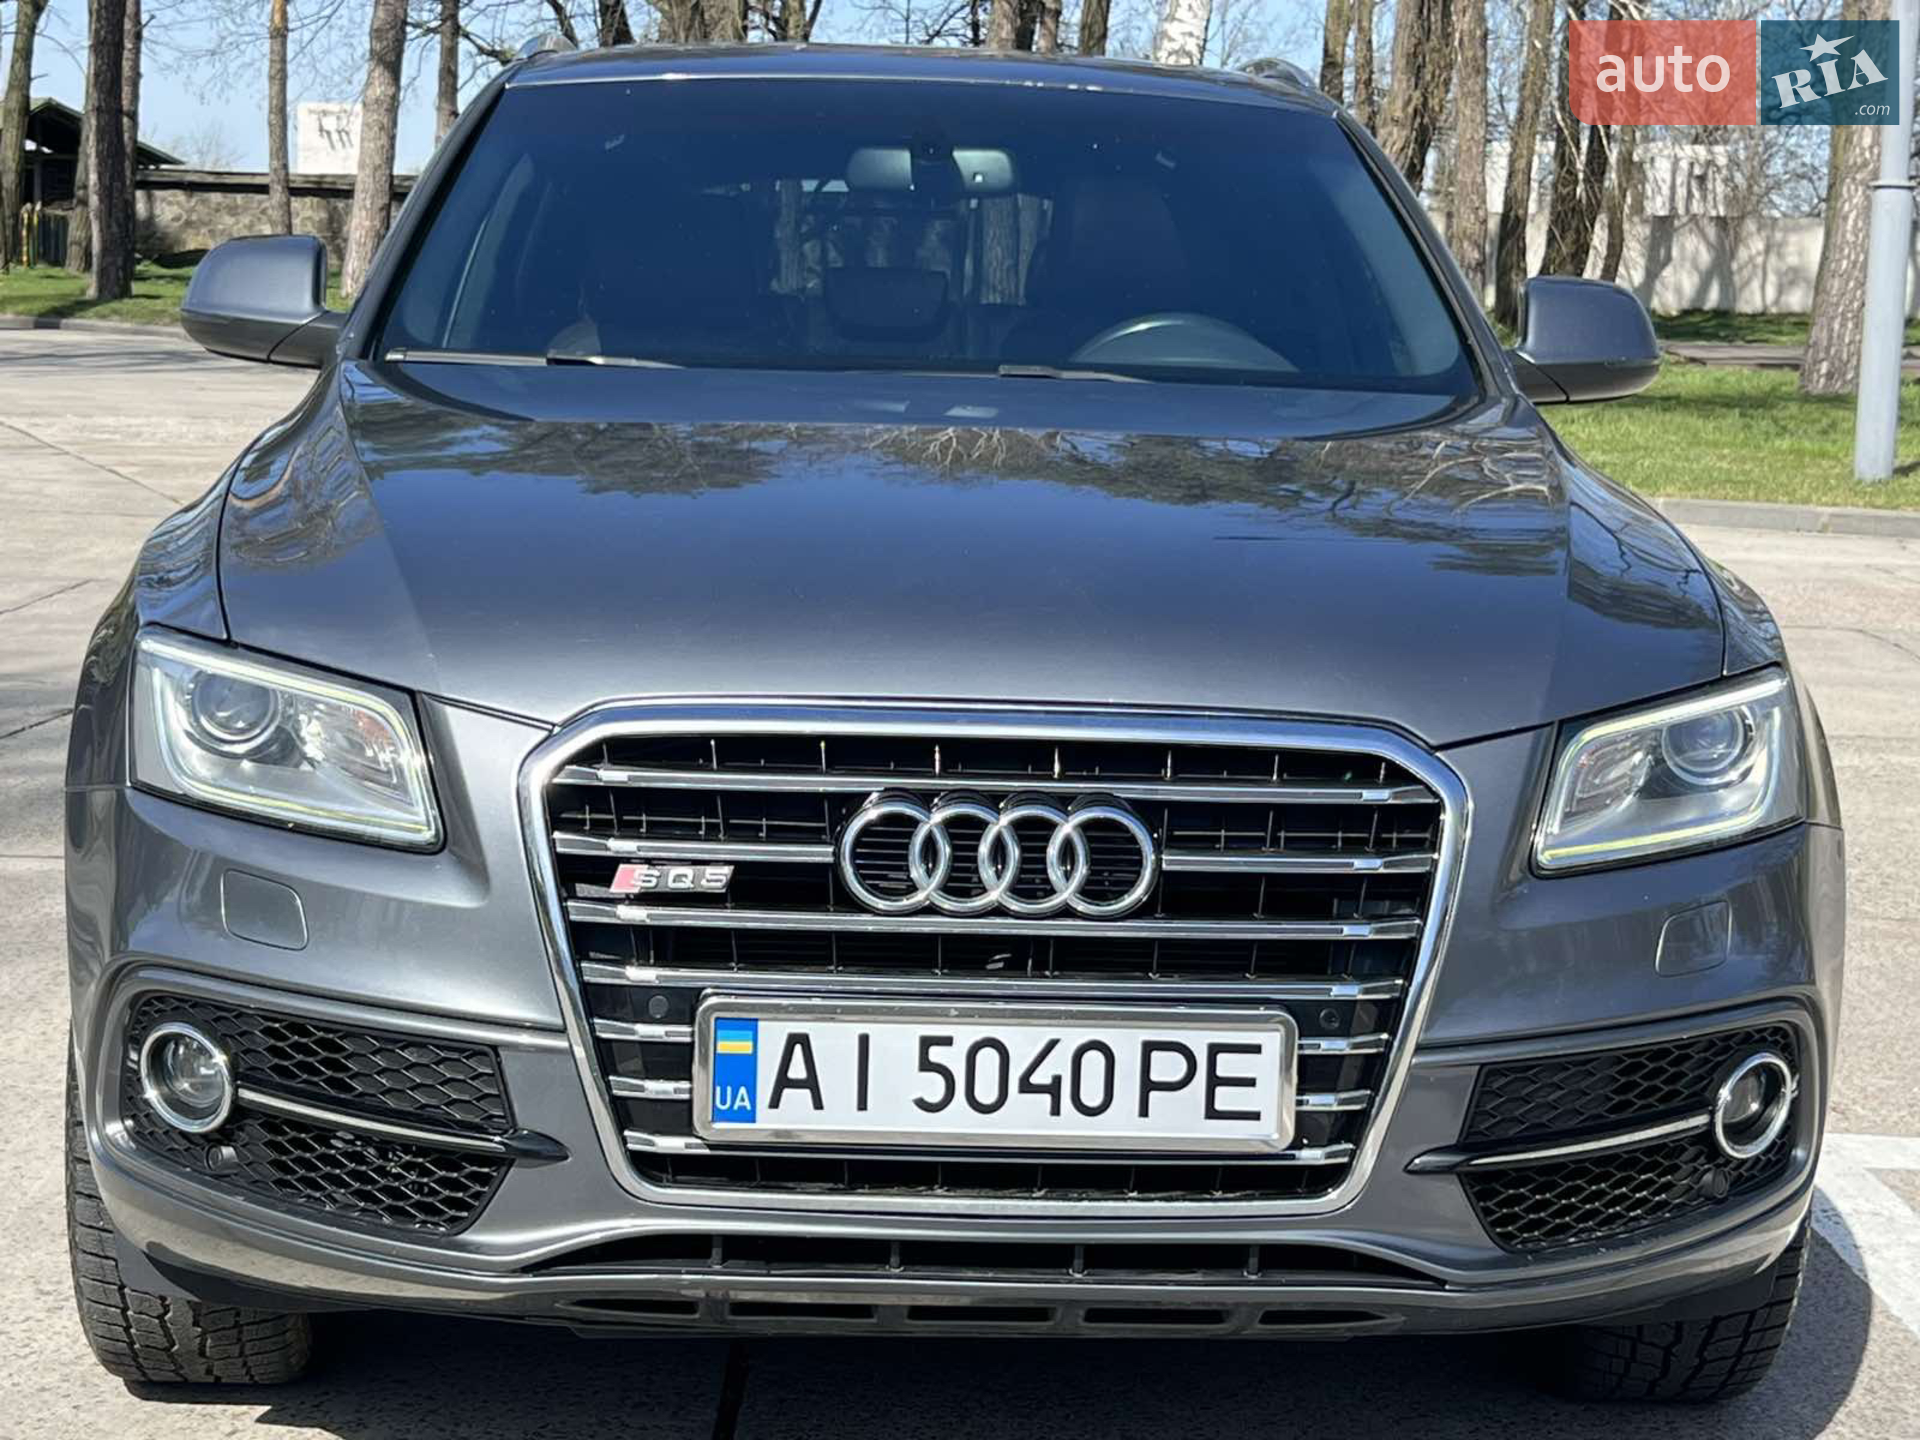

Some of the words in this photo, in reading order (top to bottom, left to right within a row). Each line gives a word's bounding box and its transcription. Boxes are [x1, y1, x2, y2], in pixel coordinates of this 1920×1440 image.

[631, 866, 731, 890] SQ5
[768, 1032, 870, 1112] AI
[912, 1034, 1116, 1117] 5040
[1138, 1039, 1263, 1122] PE
[715, 1085, 752, 1111] UA
